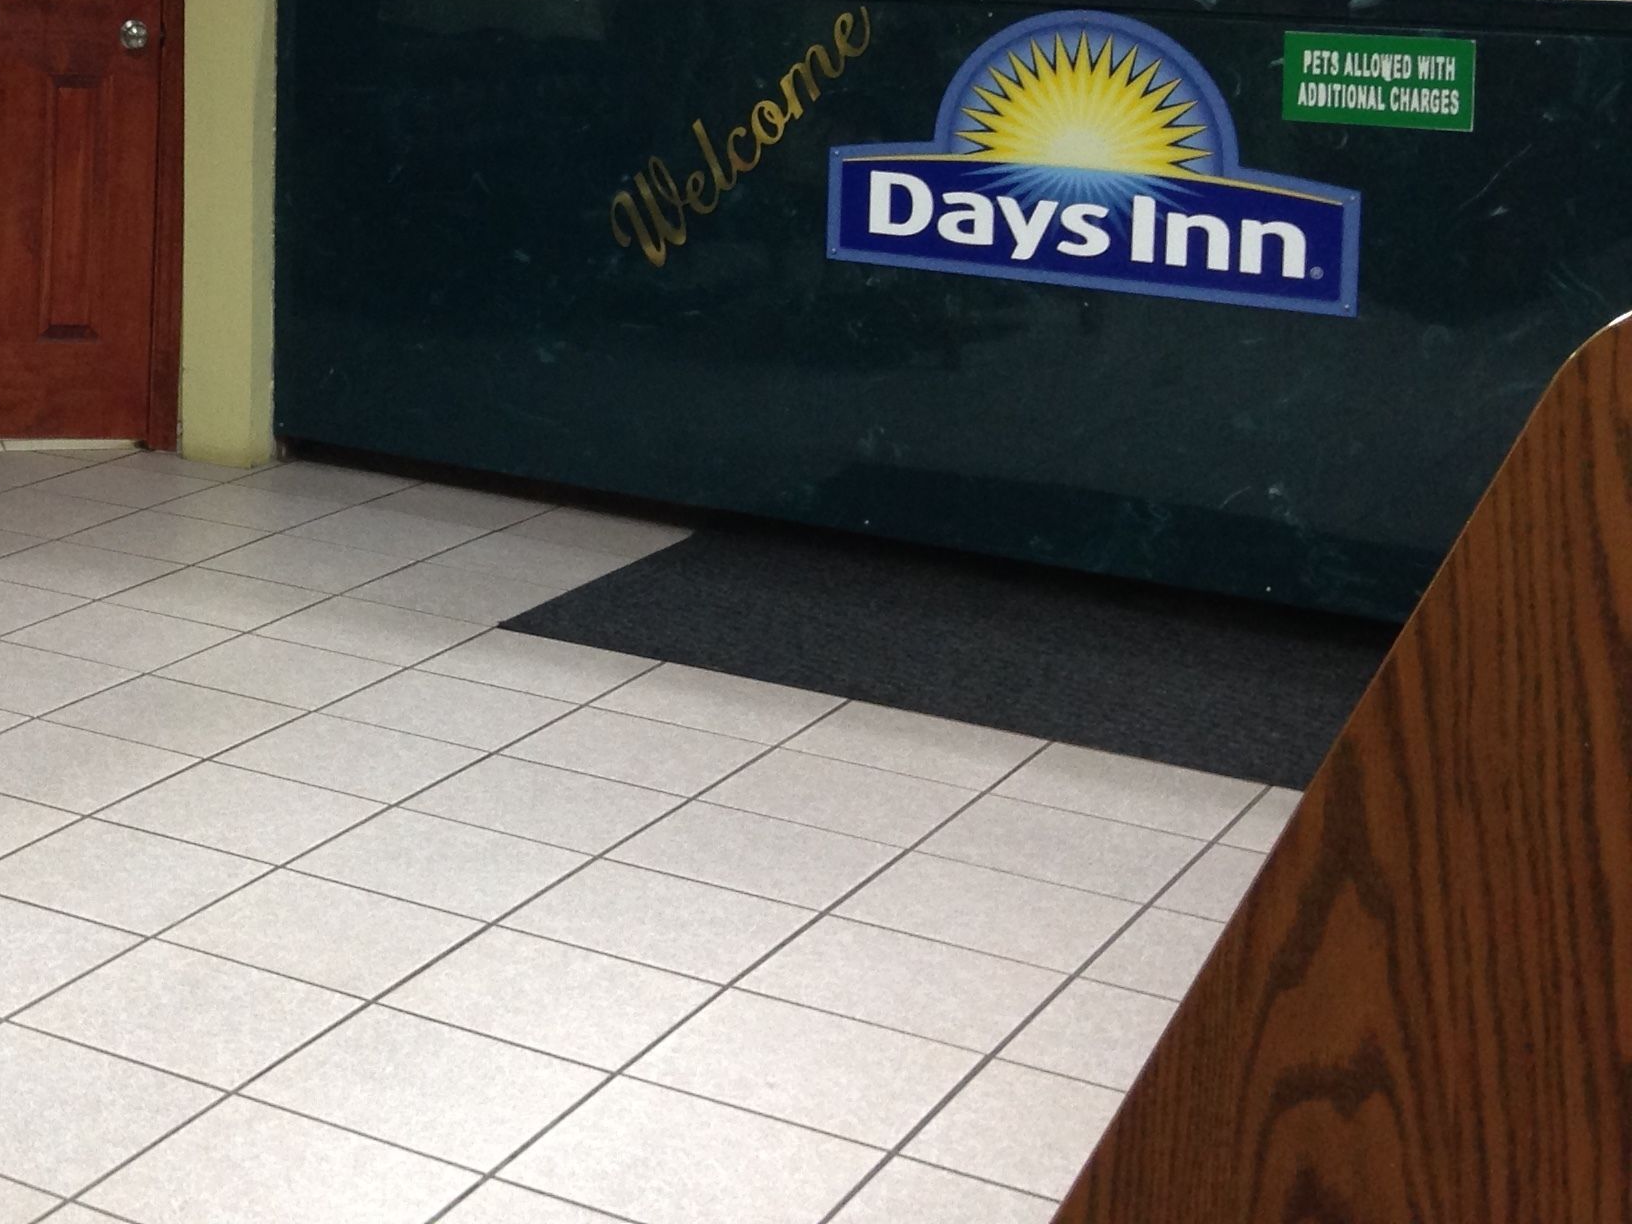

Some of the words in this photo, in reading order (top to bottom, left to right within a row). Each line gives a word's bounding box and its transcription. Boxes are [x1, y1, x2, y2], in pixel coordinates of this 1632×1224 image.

[1297, 82, 1386, 111] ADDITIONAL
[1389, 86, 1460, 115] CHARGES
[1303, 49, 1340, 76] PETS
[1343, 51, 1412, 81] ALLOWED
[1417, 55, 1456, 81] WITH
[611, 5, 872, 268] Welcome
[869, 170, 1111, 261] Days
[1129, 194, 1310, 280] Inn
